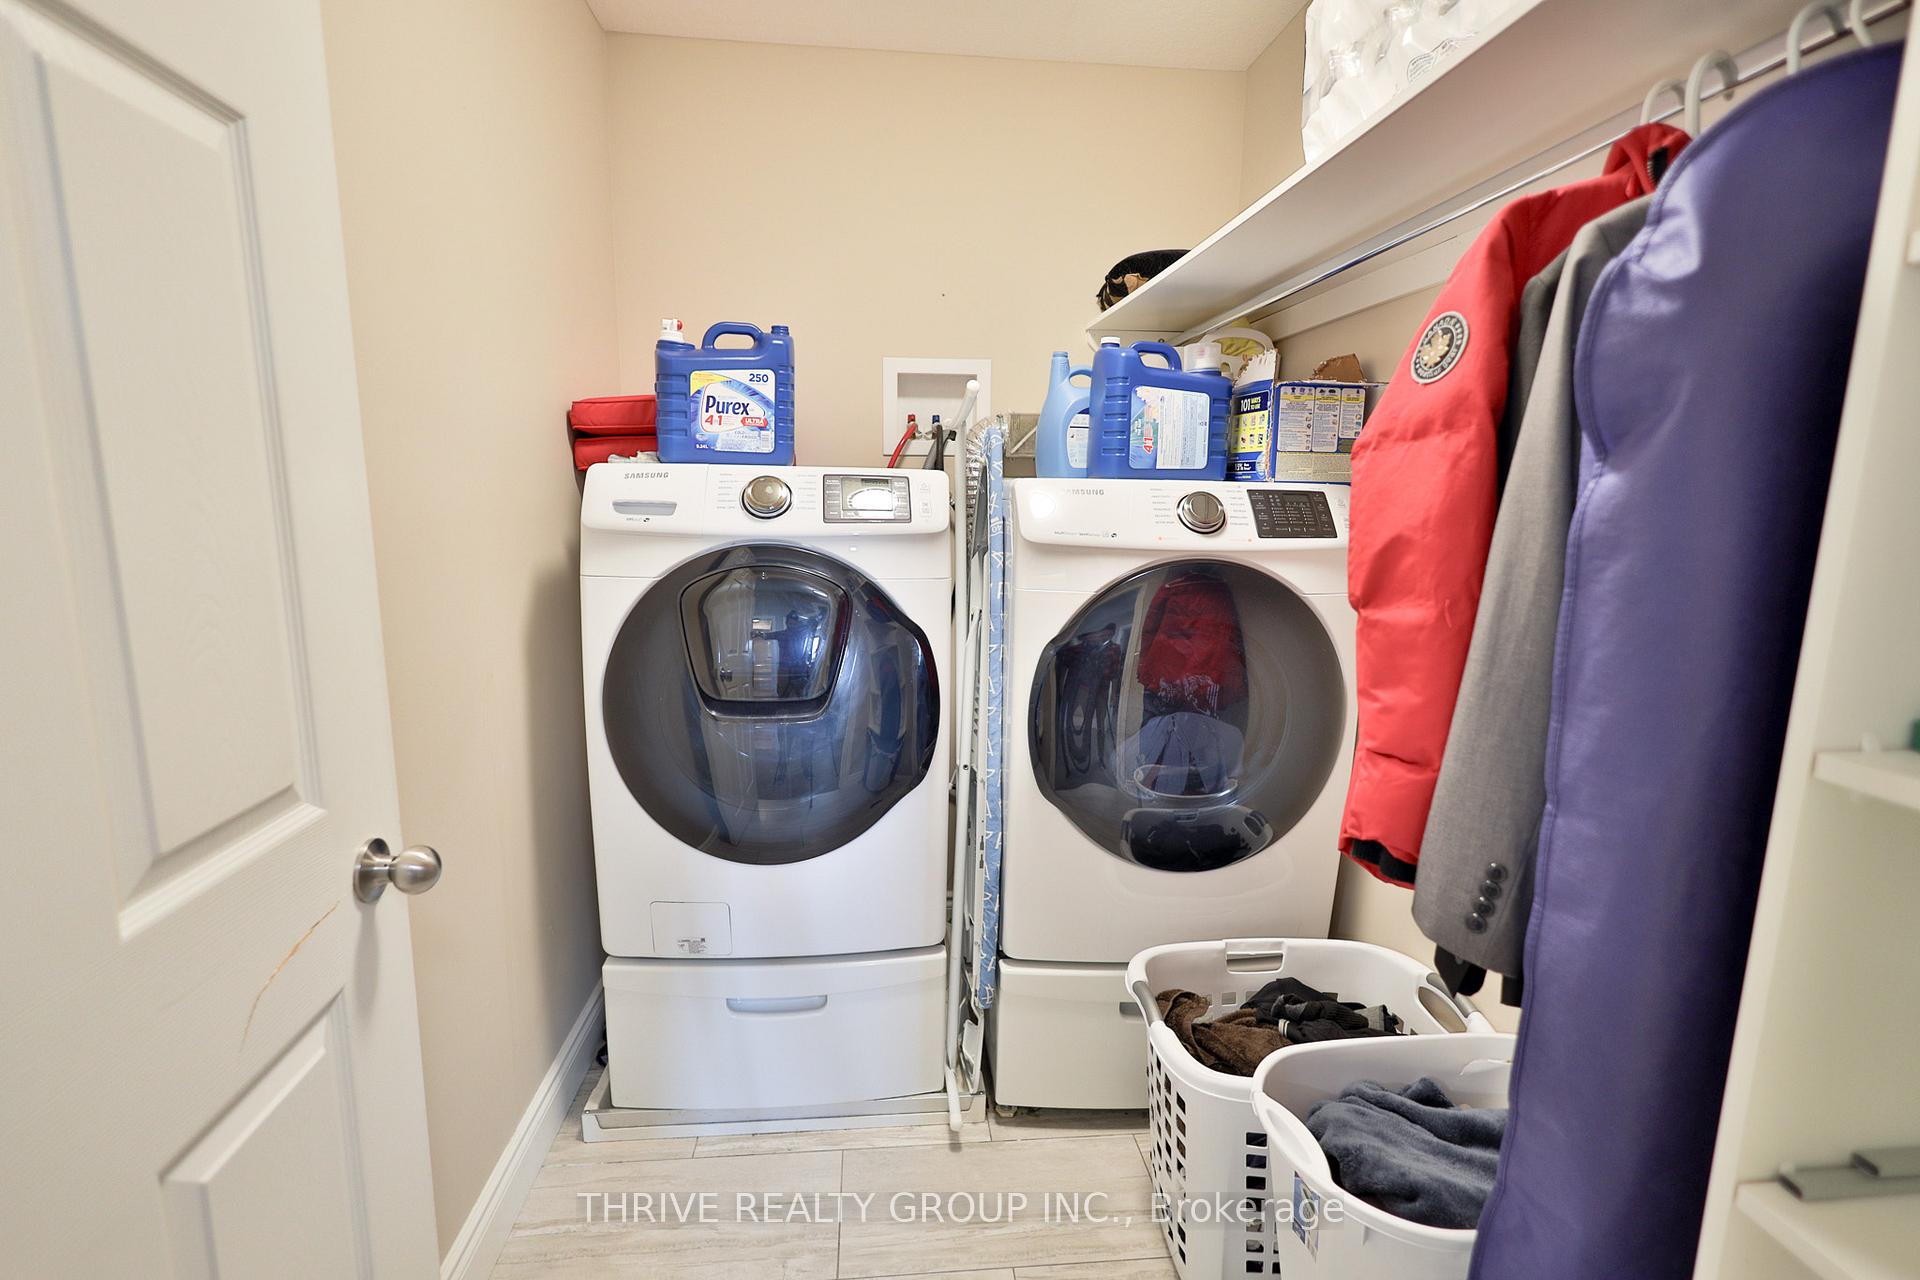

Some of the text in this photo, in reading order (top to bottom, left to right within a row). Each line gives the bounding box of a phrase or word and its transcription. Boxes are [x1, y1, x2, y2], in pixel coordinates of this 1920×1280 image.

[749, 373, 769, 383] 250
[705, 395, 750, 415] Purex
[1240, 398, 1251, 412] 101
[745, 417, 764, 425] ULTRA
[624, 471, 670, 479] SAMSUNG
[1061, 488, 1105, 496] AMSUNG
